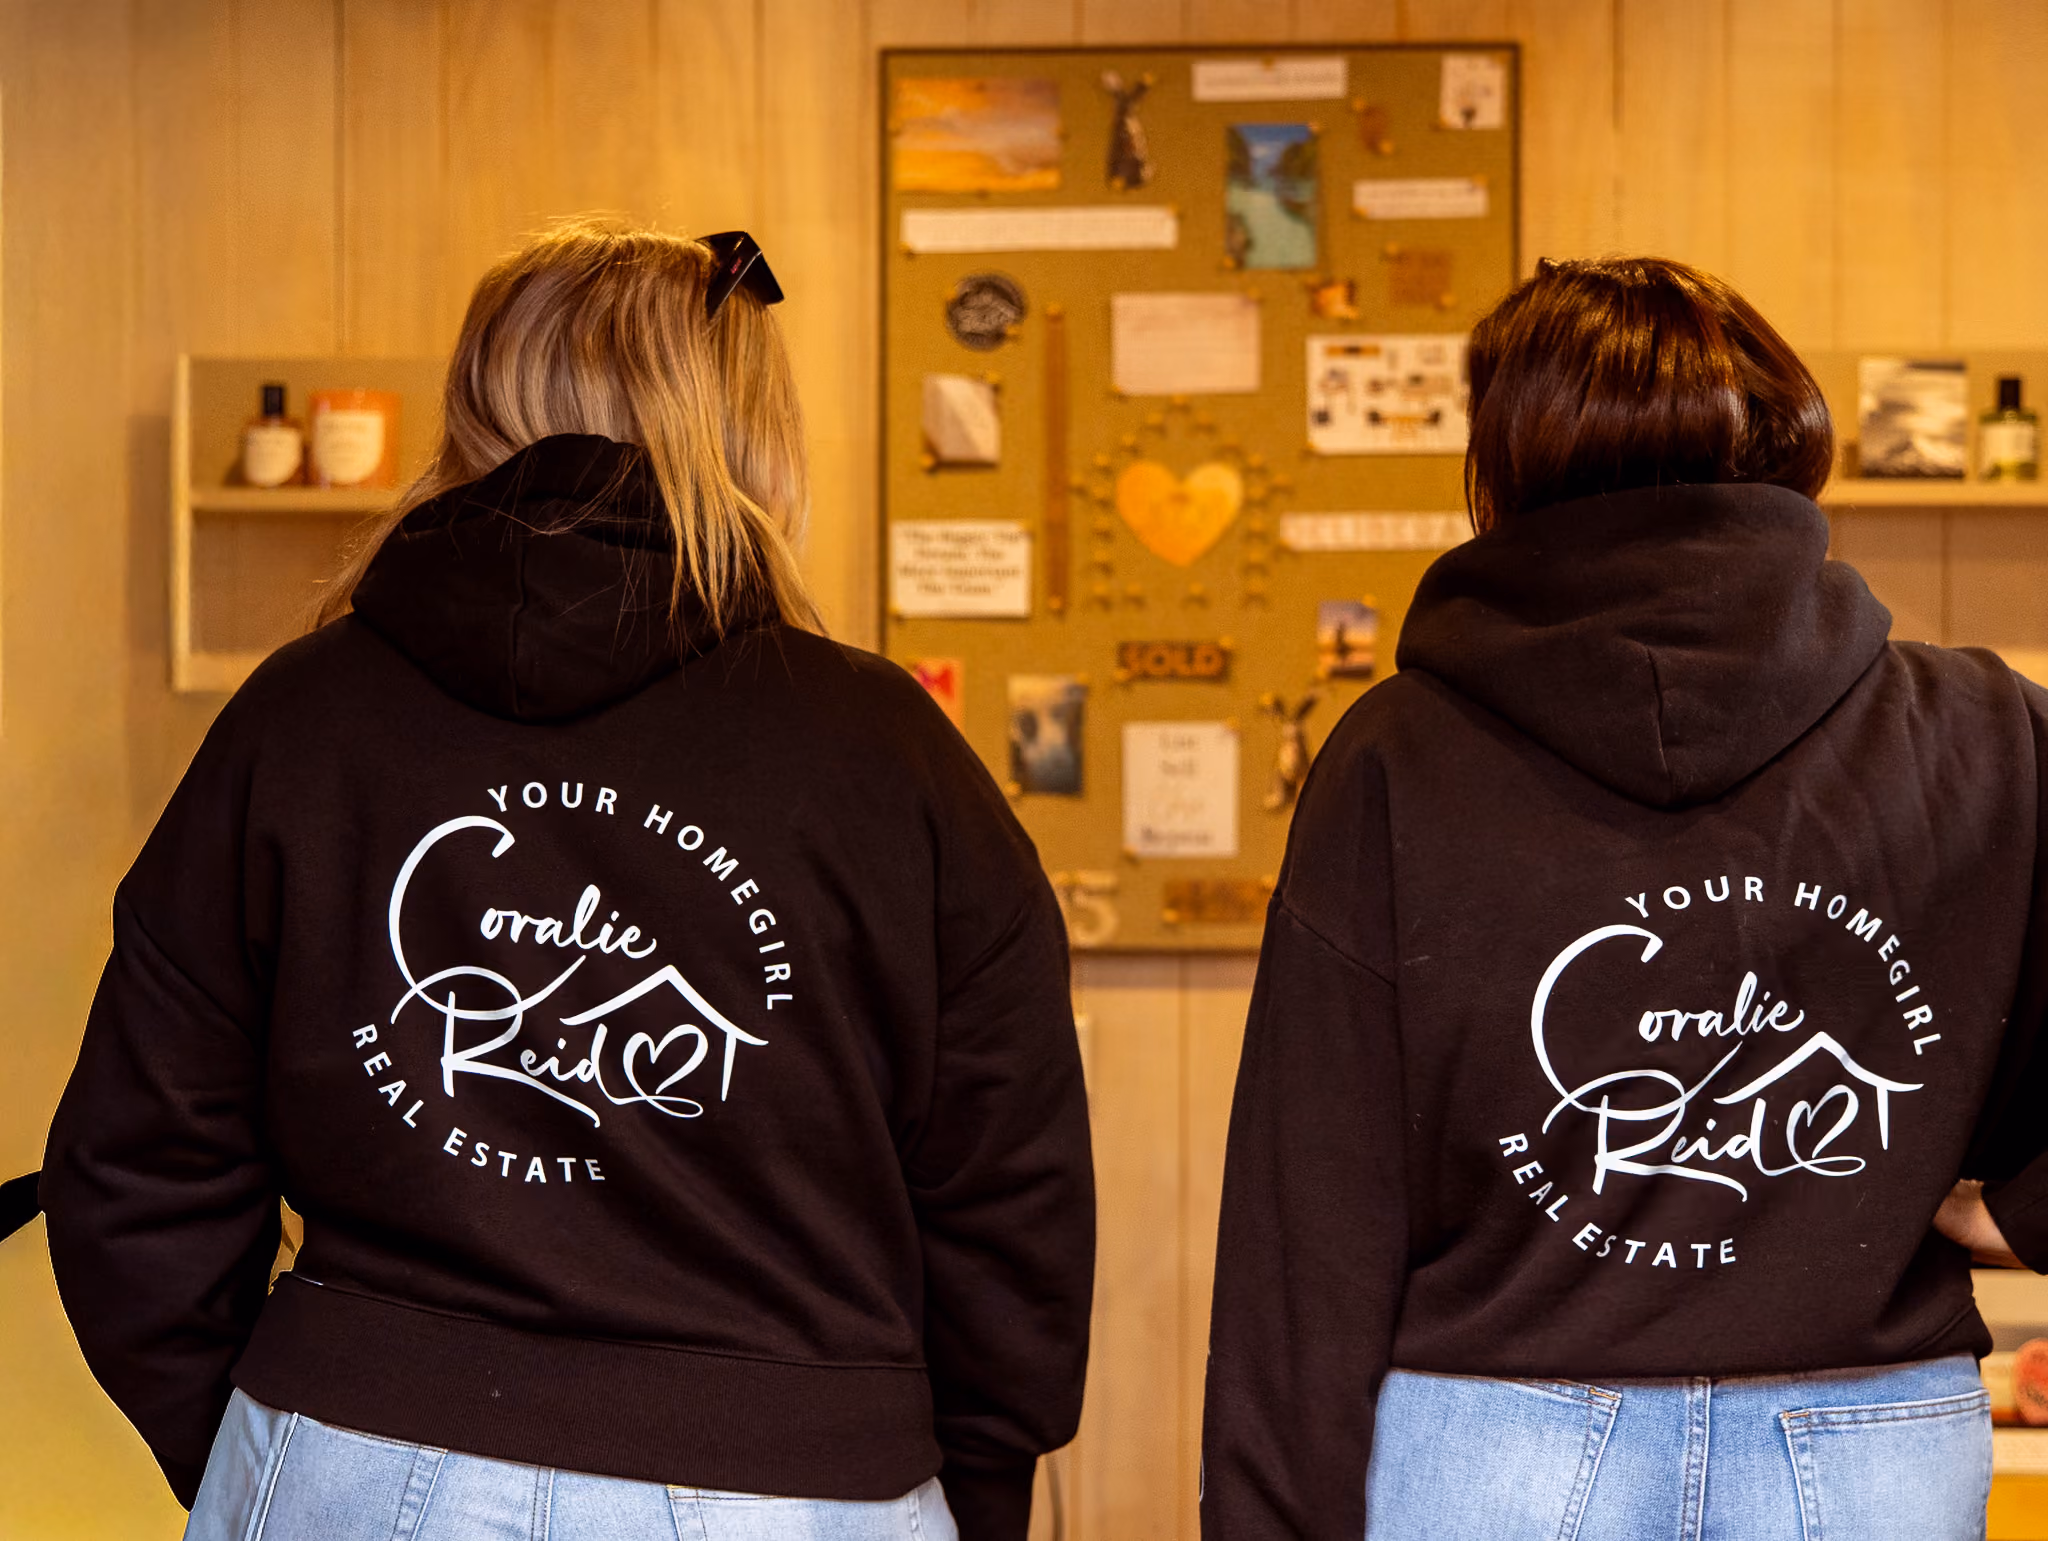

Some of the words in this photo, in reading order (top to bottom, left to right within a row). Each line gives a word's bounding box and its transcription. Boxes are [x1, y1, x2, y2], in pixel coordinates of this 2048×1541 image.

[1120, 641, 1223, 677] SOLD
[389, 815, 658, 1021] Coralie
[487, 781, 618, 815] YOUR
[643, 803, 793, 1011] HOMEGIRL
[1625, 875, 1764, 919] YOUR
[1793, 881, 1942, 1056] HOMEGIRL
[352, 1023, 425, 1129] REAL
[442, 1126, 606, 1184] ESTATE
[391, 965, 622, 1129] Reid
[1531, 924, 1805, 1121] Coralie
[1498, 1132, 1569, 1223] REAL
[1571, 1222, 1737, 1269] ESTATE
[1541, 1069, 1785, 1203] Reid
